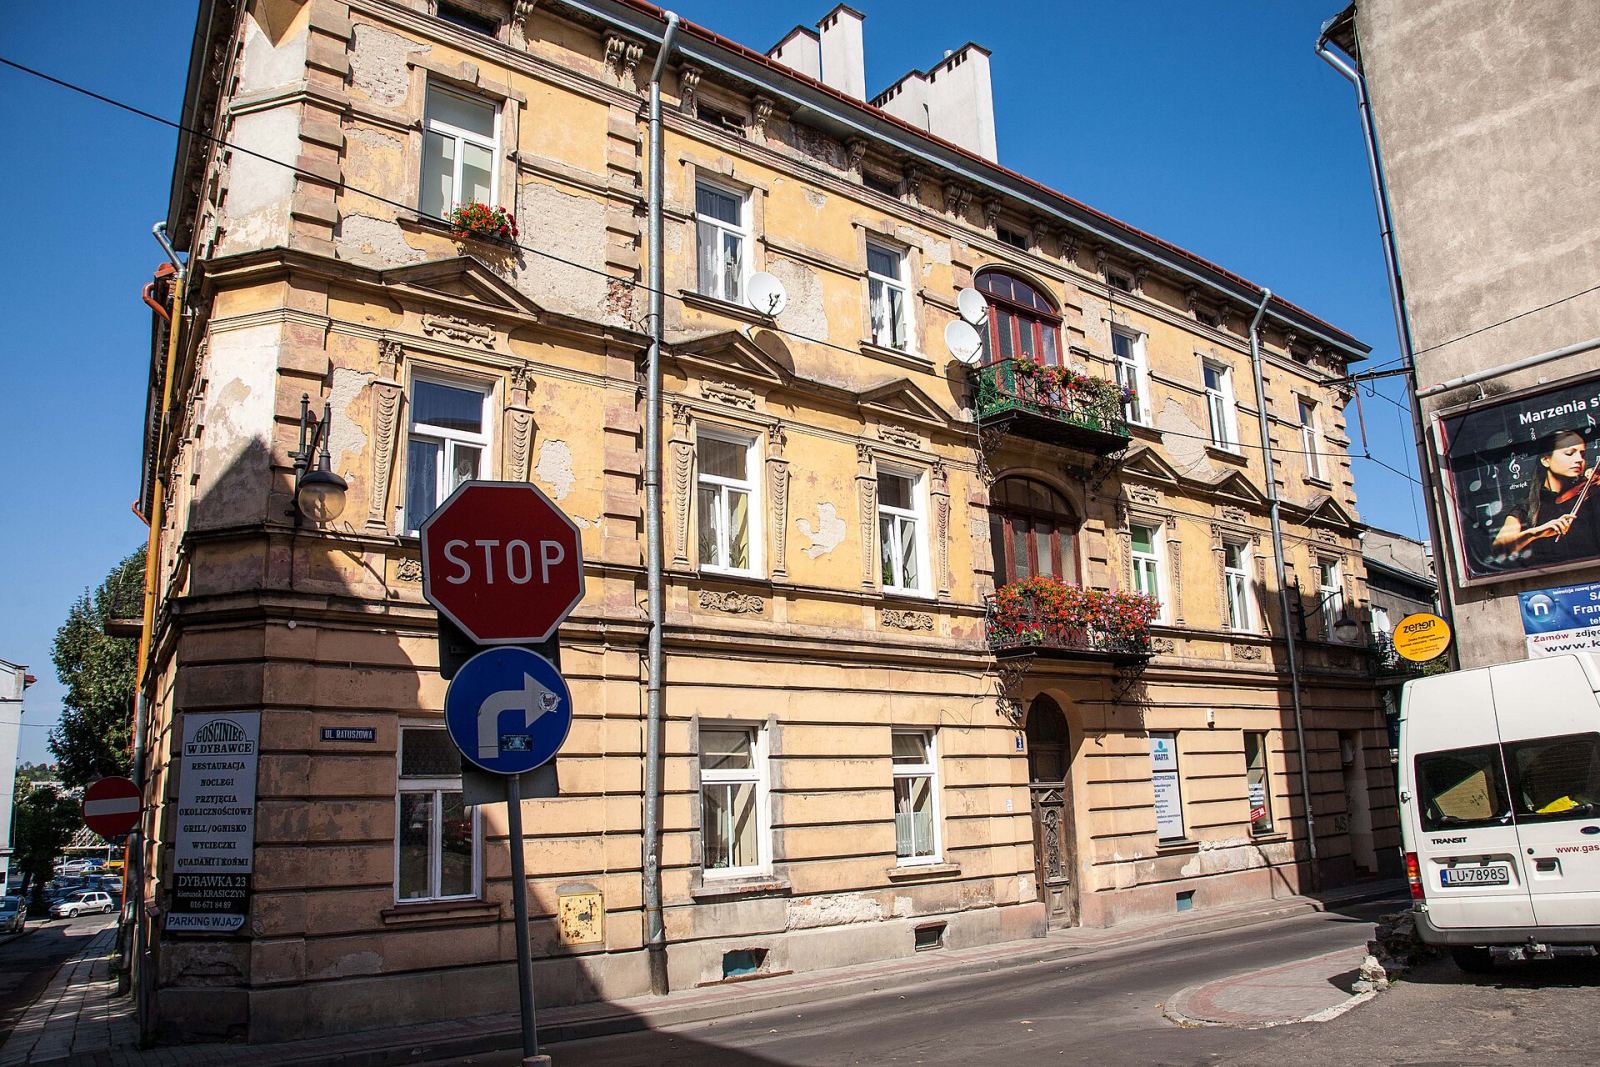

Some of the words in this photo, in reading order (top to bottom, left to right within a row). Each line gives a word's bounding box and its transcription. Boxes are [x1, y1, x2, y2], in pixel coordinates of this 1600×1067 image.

[1519, 399, 1587, 425] Marzenia
[443, 539, 565, 585] STOP
[1533, 632, 1569, 643] Zamów
[336, 730, 373, 739] RATUSZOWA
[188, 744, 198, 754] W
[200, 743, 252, 754] DYBAWCE
[192, 761, 246, 771] RESTAURACJA
[200, 778, 234, 787] NOCLEGI
[195, 794, 237, 804] PRZYJĘCIA
[179, 806, 253, 817] OKOLICZNOŚCIOWE
[192, 841, 237, 849] WYCIECZKI
[1431, 837, 1467, 845] TRANSIT
[178, 858, 214, 867] QUADAMI
[221, 857, 249, 867] KOŃMI
[1449, 870, 1465, 882] LU
[1468, 868, 1506, 881] 7898S
[178, 876, 233, 887] DYBAWKA
[235, 876, 247, 887] 23
[203, 889, 246, 898] KRASICZYN
[168, 917, 210, 926] PARKING
